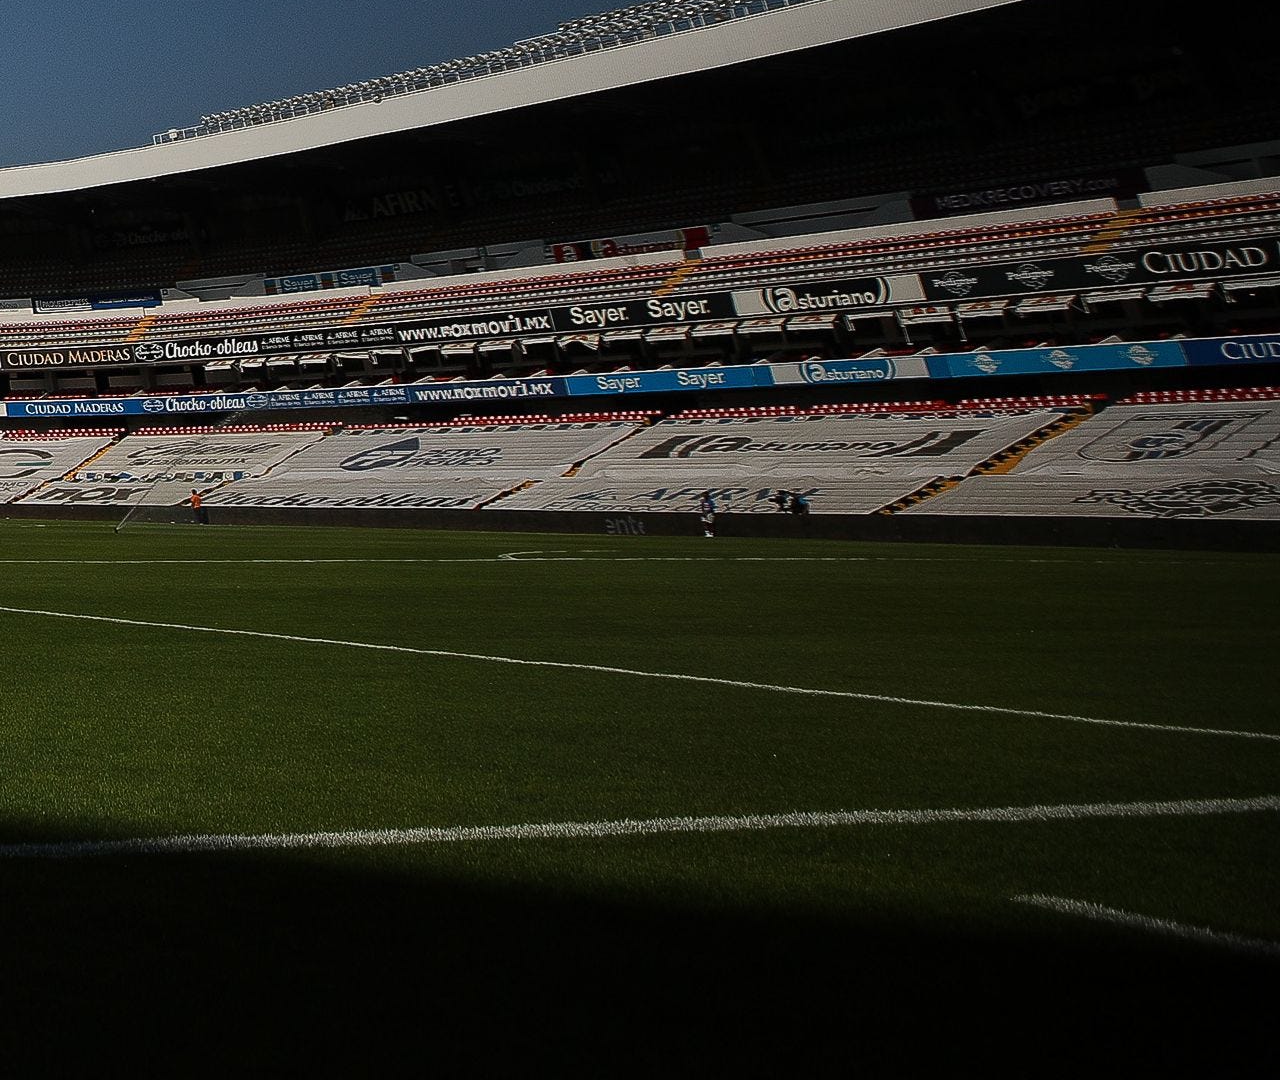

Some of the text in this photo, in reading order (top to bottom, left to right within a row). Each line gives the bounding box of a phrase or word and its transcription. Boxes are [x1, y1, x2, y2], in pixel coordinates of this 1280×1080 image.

[1142, 246, 1268, 274] CIUDAD
[7, 349, 131, 367] CIUDAD MADERAS
[25, 402, 124, 415] CIUDAD MADERAS
